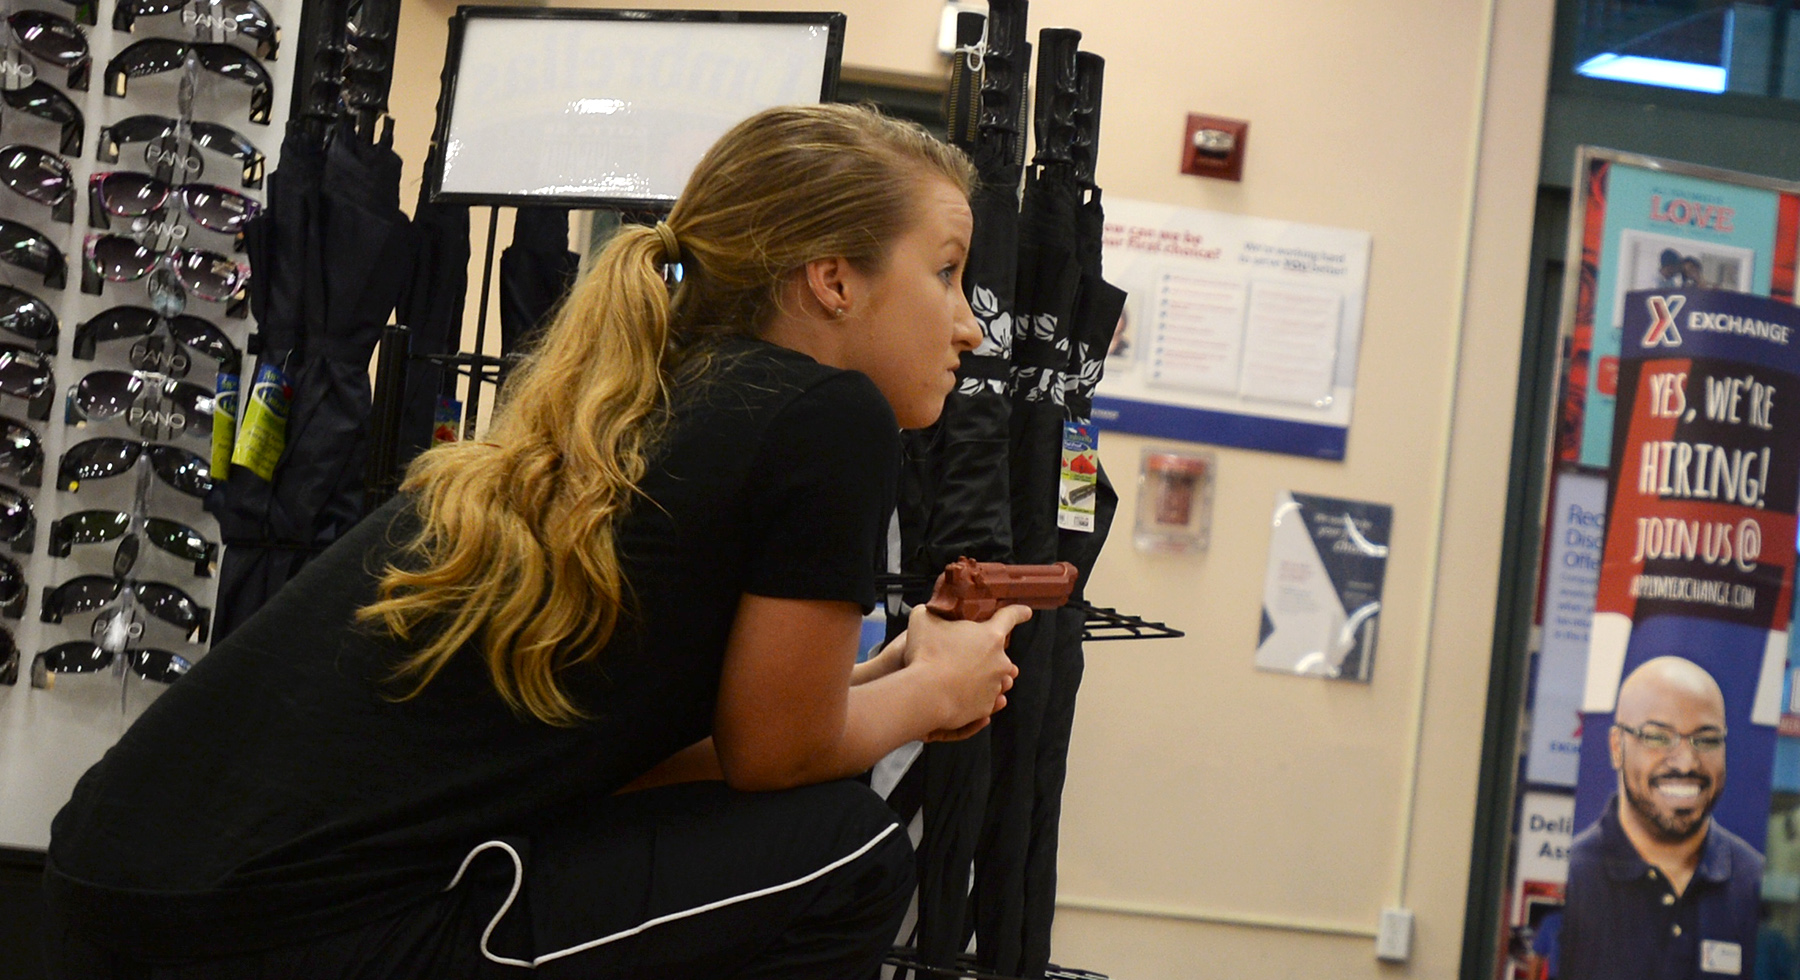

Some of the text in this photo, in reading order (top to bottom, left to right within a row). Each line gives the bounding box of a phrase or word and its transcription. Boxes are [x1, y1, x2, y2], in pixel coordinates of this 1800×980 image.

[183, 11, 238, 32] PANO
[1650, 194, 1736, 233] LOVE
[1103, 221, 1124, 235] ow
[1102, 235, 1123, 248] our
[1688, 310, 1791, 344] EXCHANGE
[132, 345, 187, 369] PANO
[1650, 373, 1776, 430] YES, WE'RE
[130, 409, 185, 429] PANO
[1639, 441, 1771, 509] HIRING!
[1632, 517, 1700, 564] JOIN
[1702, 522, 1733, 566] US
[94, 619, 142, 638] PO
